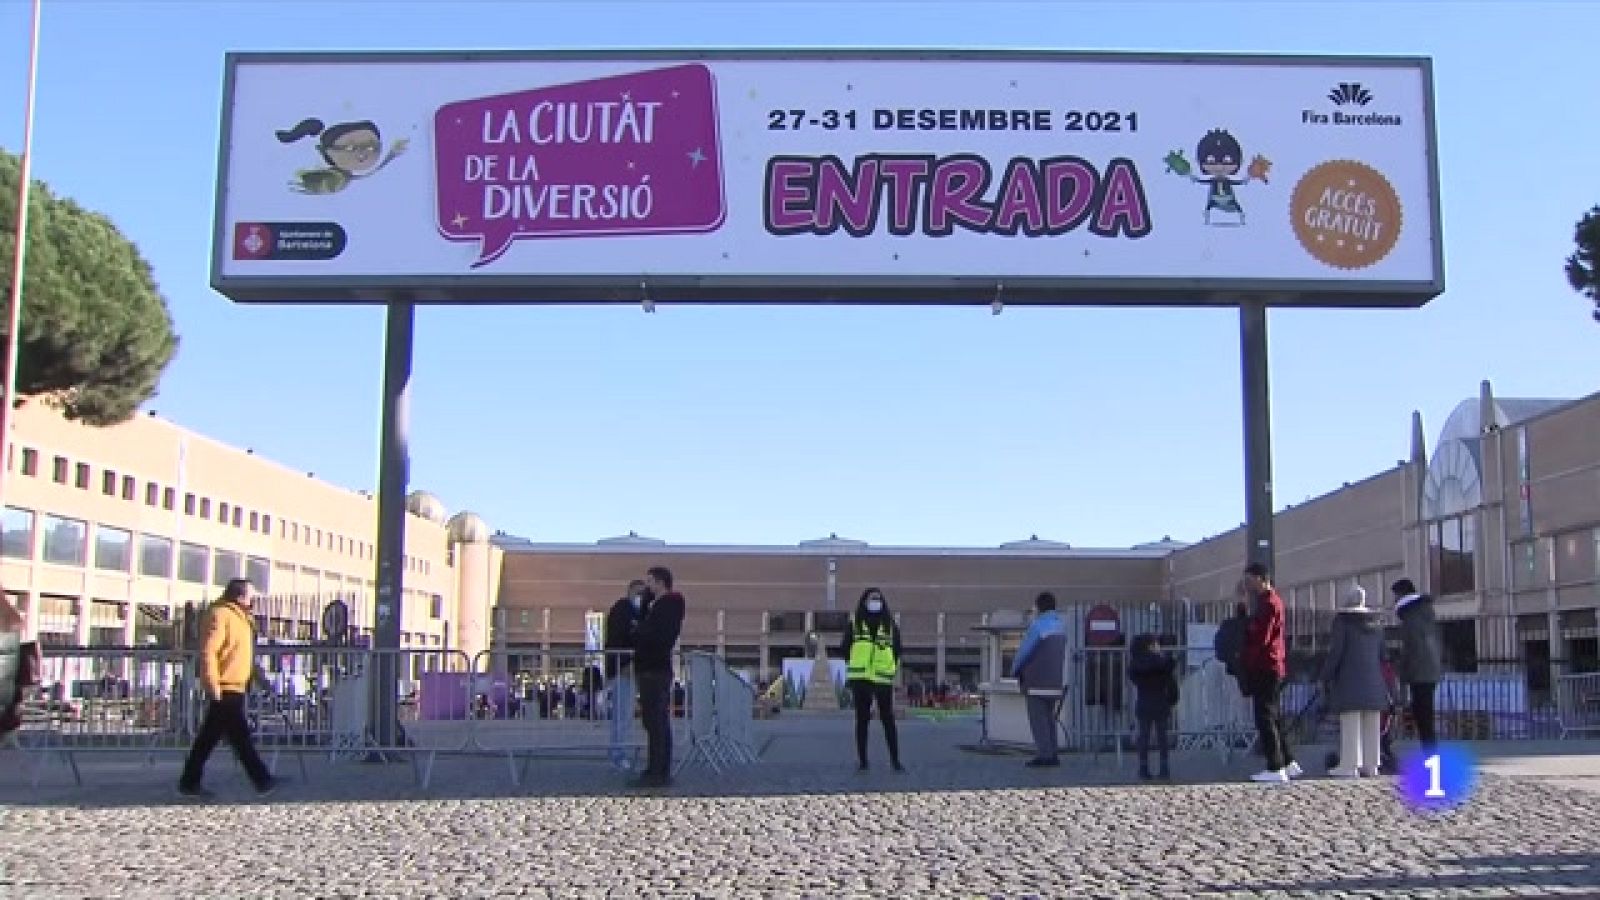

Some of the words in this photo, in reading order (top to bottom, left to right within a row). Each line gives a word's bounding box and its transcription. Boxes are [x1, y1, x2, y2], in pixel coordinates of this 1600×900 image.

[483, 109, 521, 144] LA
[767, 108, 857, 132] 27-31
[872, 109, 1052, 132] DESEMBRE
[1064, 111, 1138, 133] 2021
[1301, 110, 1329, 124] Fira
[1333, 112, 1402, 126] Barcelona
[464, 154, 499, 181] DE
[507, 154, 539, 181] LA
[483, 174, 654, 220] DIVERSIÓ
[765, 154, 1152, 238] ENTRADA
[277, 239, 333, 250] Barcelona
